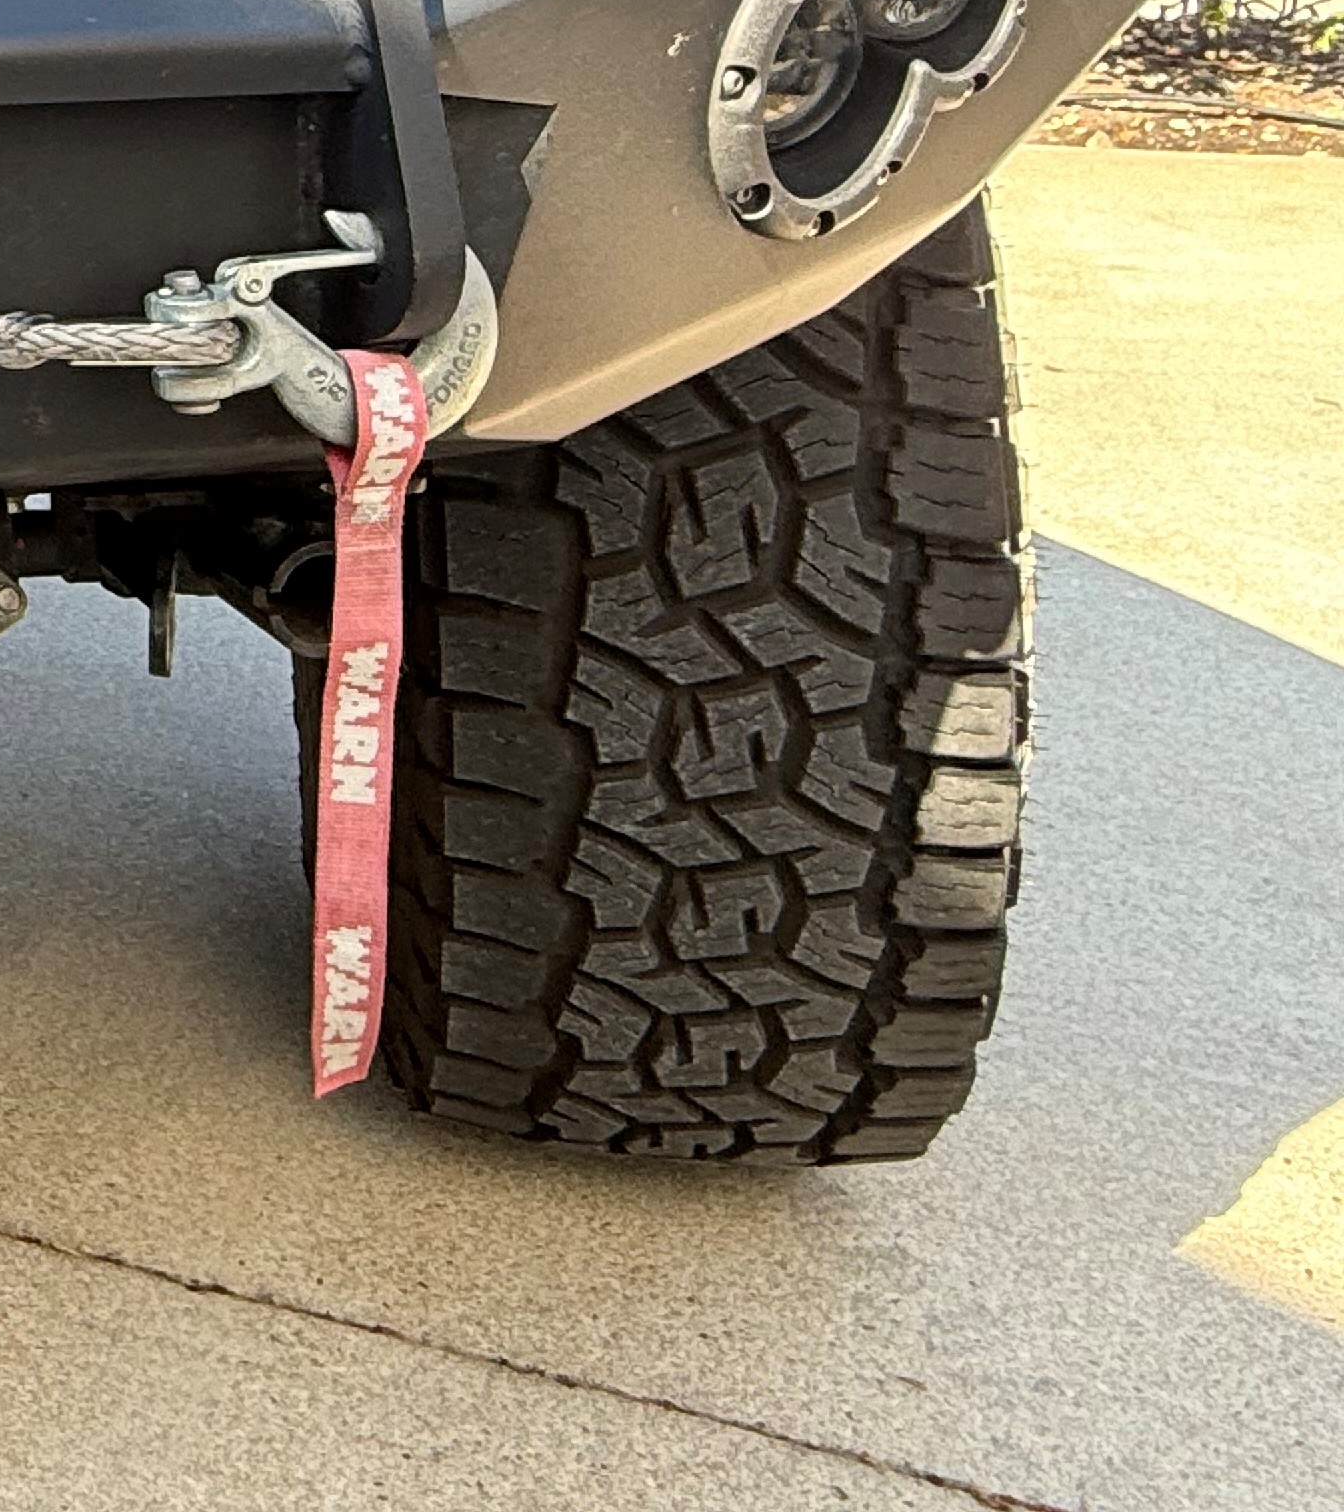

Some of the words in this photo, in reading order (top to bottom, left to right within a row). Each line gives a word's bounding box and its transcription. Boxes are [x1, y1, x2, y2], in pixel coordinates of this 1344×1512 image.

[350, 363, 416, 524] WARN
[330, 642, 390, 805] WARN
[320, 925, 373, 1078] WARN
